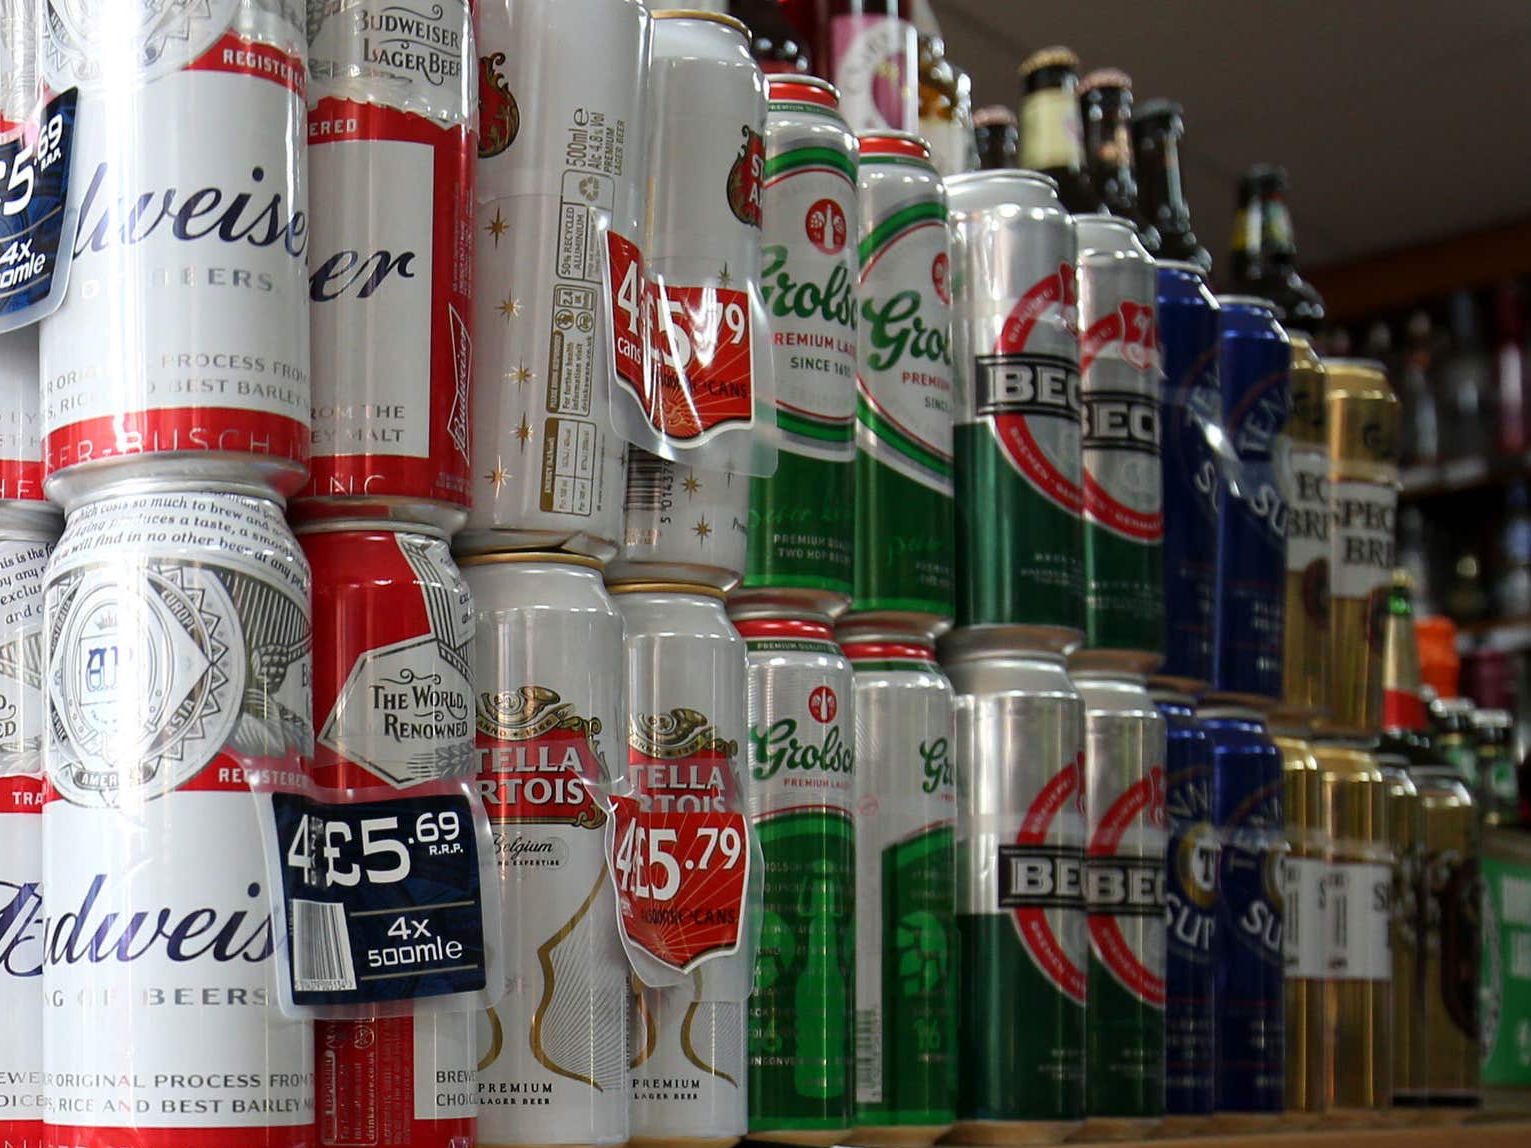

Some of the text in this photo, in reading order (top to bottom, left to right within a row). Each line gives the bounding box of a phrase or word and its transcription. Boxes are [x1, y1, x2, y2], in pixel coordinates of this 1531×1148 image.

[602, 127, 616, 174] PREMIUM
[614, 120, 626, 176] LAGER BEER
[562, 207, 576, 254] RECYCLED
[573, 213, 586, 272] ALUMINIUM
[790, 357, 830, 372] SINCE
[192, 499, 271, 531] to brew and
[193, 517, 236, 536] taste,
[94, 530, 122, 550] find
[127, 531, 142, 544] in
[147, 531, 168, 543] no
[171, 530, 216, 547] other
[16, 555, 26, 568] is
[26, 548, 45, 565] the
[15, 568, 40, 585] any
[4, 605, 33, 625] and
[369, 684, 409, 711] THE
[383, 713, 469, 744] RENOWNED
[475, 746, 584, 774] TELLA
[630, 764, 726, 791] TELLA
[475, 777, 586, 805] RTOIS
[288, 813, 312, 886] 4
[324, 811, 461, 888] £5.69
[428, 843, 465, 857] R.R.P.
[57, 1074, 262, 1089] ORIGINAL PROCESS
[477, 1083, 553, 1095] PREMIUM
[632, 1078, 701, 1090] PREMIUM
[479, 1098, 551, 1106] LAGER BEER
[634, 1091, 699, 1101] LAGER BEER
[58, 1098, 302, 1115] RICE AND BEST BARLEY
